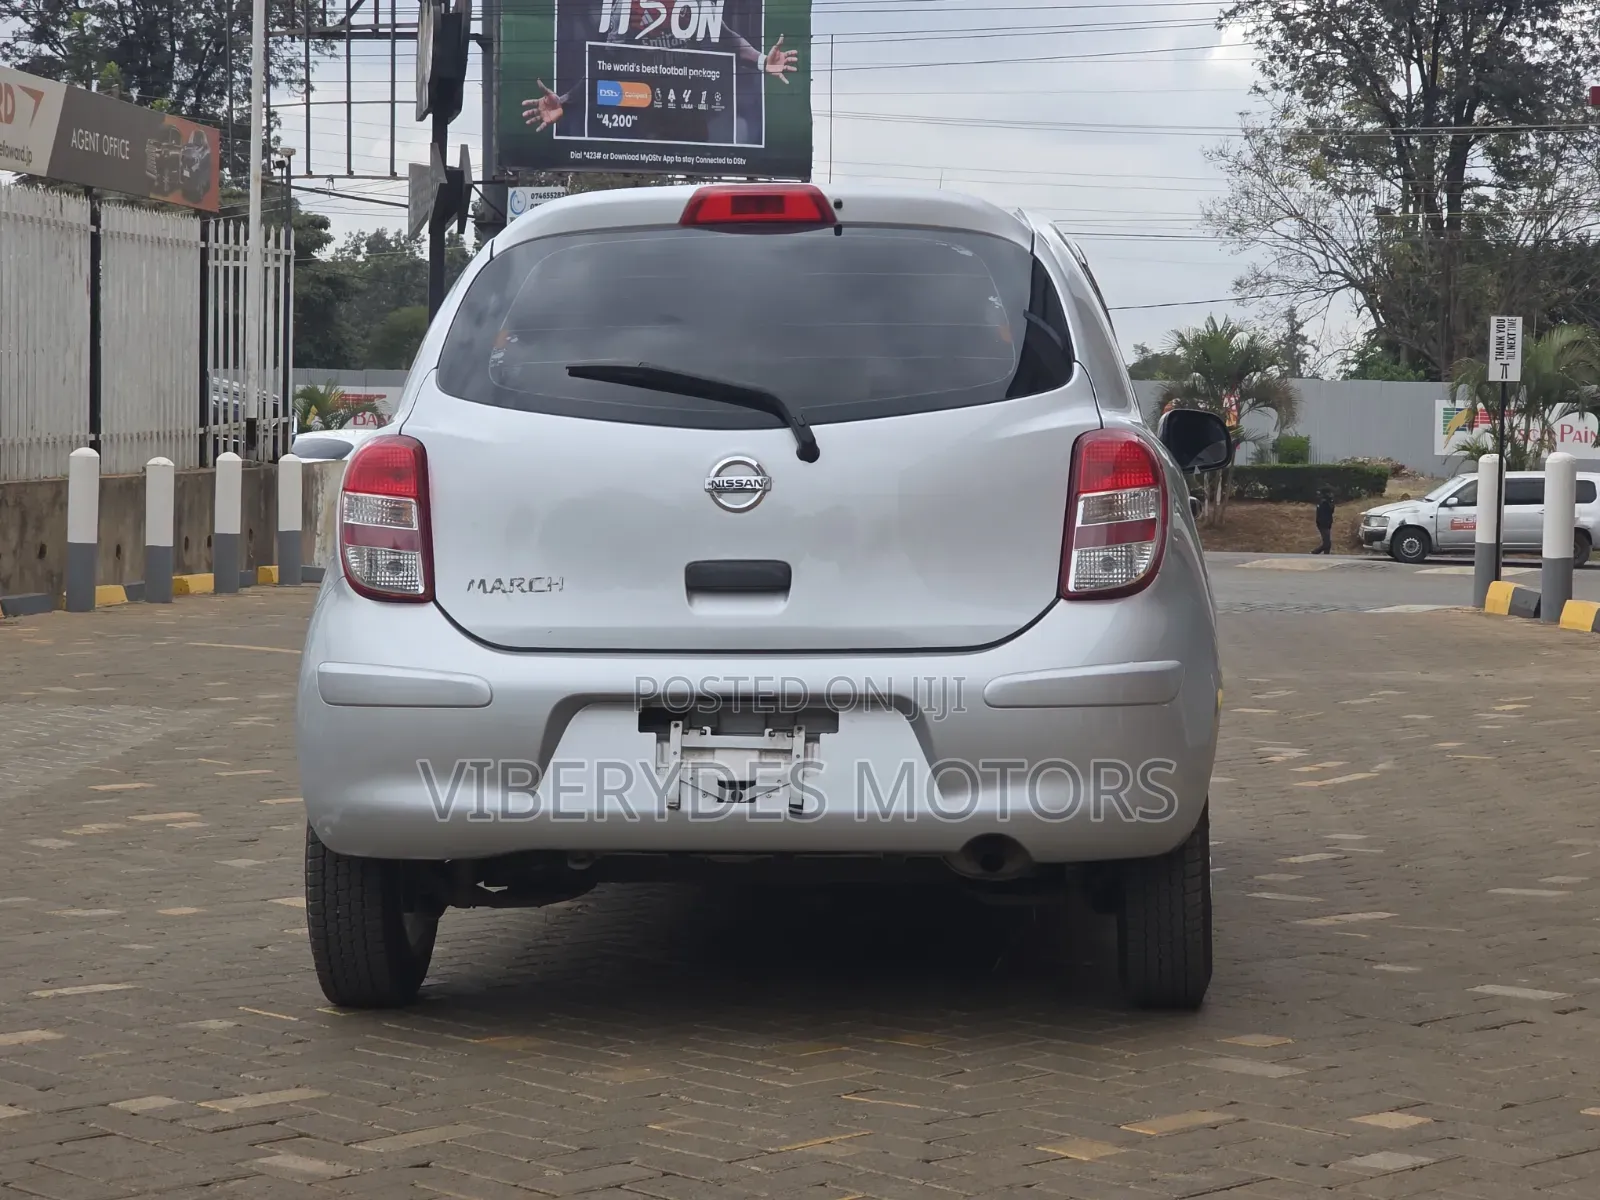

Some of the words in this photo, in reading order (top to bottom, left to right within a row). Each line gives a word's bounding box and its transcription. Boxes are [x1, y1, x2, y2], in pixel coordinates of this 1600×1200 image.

[597, 60, 612, 71] The
[613, 62, 640, 73] world's
[641, 63, 658, 74] best
[659, 65, 688, 76] football
[688, 68, 721, 80] package
[602, 114, 632, 128] 4,200
[70, 128, 100, 153] AGENT
[102, 134, 130, 160] OFFICE
[570, 151, 583, 159] Dial
[610, 152, 640, 161] Download
[640, 153, 662, 163] MyDStv
[662, 154, 675, 164] App
[675, 155, 682, 163] to
[682, 156, 695, 165] stay
[695, 156, 726, 165] Connected
[726, 157, 733, 165] to
[1495, 318, 1506, 334] YOU
[1507, 318, 1517, 331] TIME
[1495, 335, 1505, 361] THANK
[711, 479, 764, 488] NISSAN
[467, 577, 564, 594] MARCH
